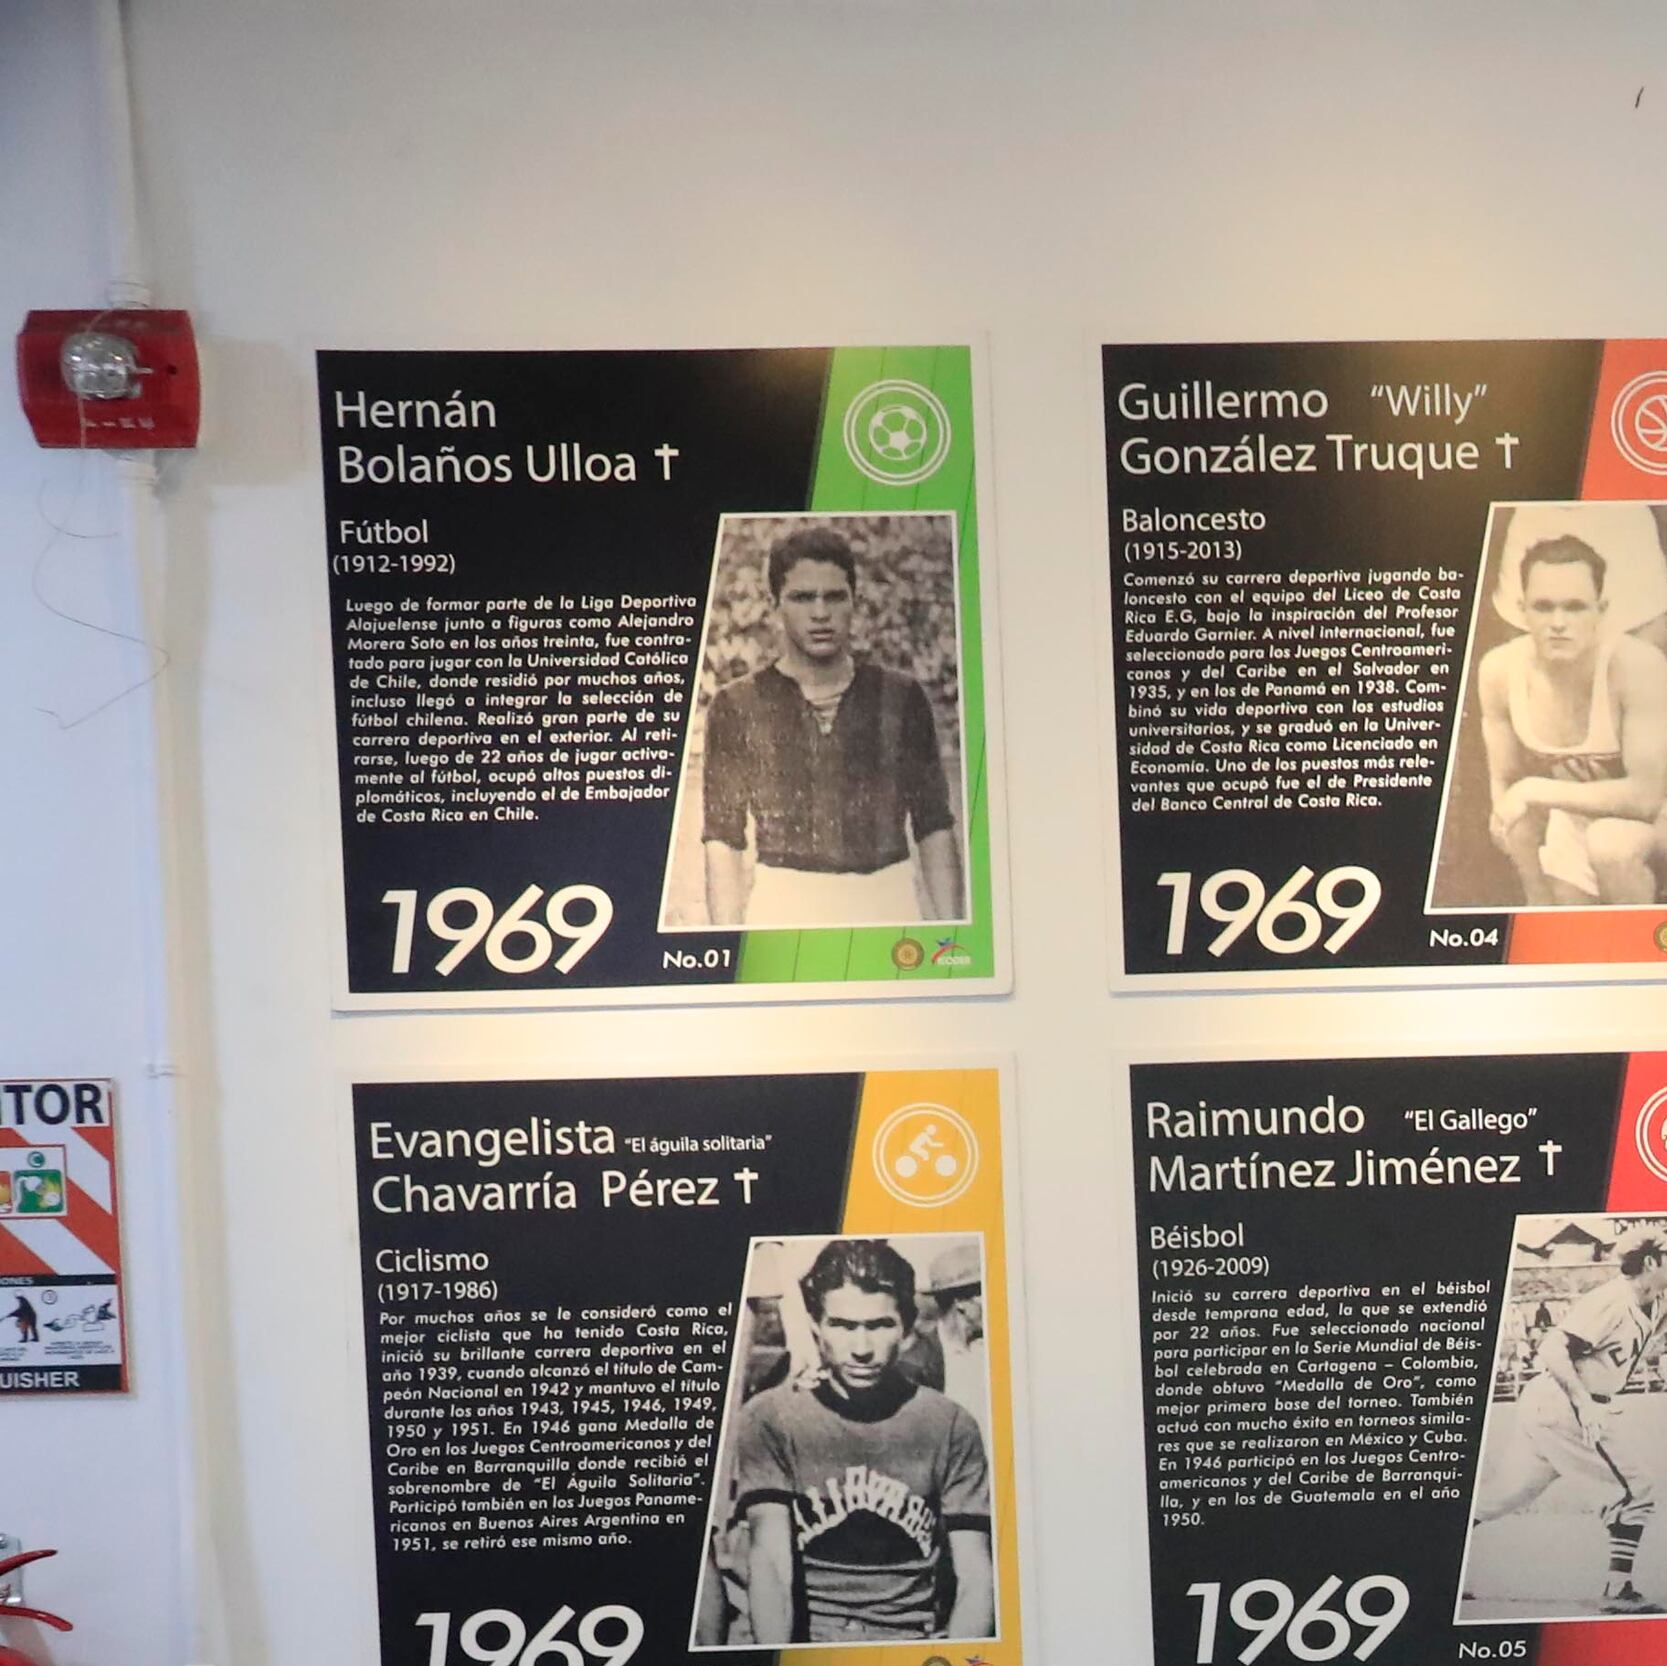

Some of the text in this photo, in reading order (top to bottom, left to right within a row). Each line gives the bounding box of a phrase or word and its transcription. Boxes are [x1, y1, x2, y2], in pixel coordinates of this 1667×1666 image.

[336, 390, 496, 428] Hernán
[1119, 381, 1328, 420] Guillermo
[340, 443, 636, 483] Bolaños Ulloa
[1121, 434, 1479, 480] González Truque
[341, 519, 428, 544] Fútbol
[1123, 508, 1266, 532] Baloncesto
[333, 553, 456, 576] (1912-1992)
[1125, 540, 1242, 563] (1915-2013)
[357, 806, 539, 823] de Costa Rica en Chile.
[1158, 866, 1381, 957] 1969
[382, 884, 613, 976] 1969
[1430, 928, 1498, 947] No.04
[663, 950, 730, 969] No.01
[0, 1083, 104, 1125] TOR
[1148, 1095, 1365, 1138] Raimundo
[371, 1117, 615, 1167] Evangelista
[650, 1136, 699, 1156] águila
[1150, 1147, 1521, 1192] Martínez Jiménez
[373, 1169, 719, 1213] Chavarría Pérez
[1151, 1222, 1244, 1249] Béisbol
[376, 1248, 489, 1273] Ciclismo
[1153, 1256, 1269, 1280] (1926-2009)
[378, 1280, 498, 1304] (1917-1986)
[1187, 1575, 1410, 1666] 1969
[1459, 1640, 1526, 1659] No.05
